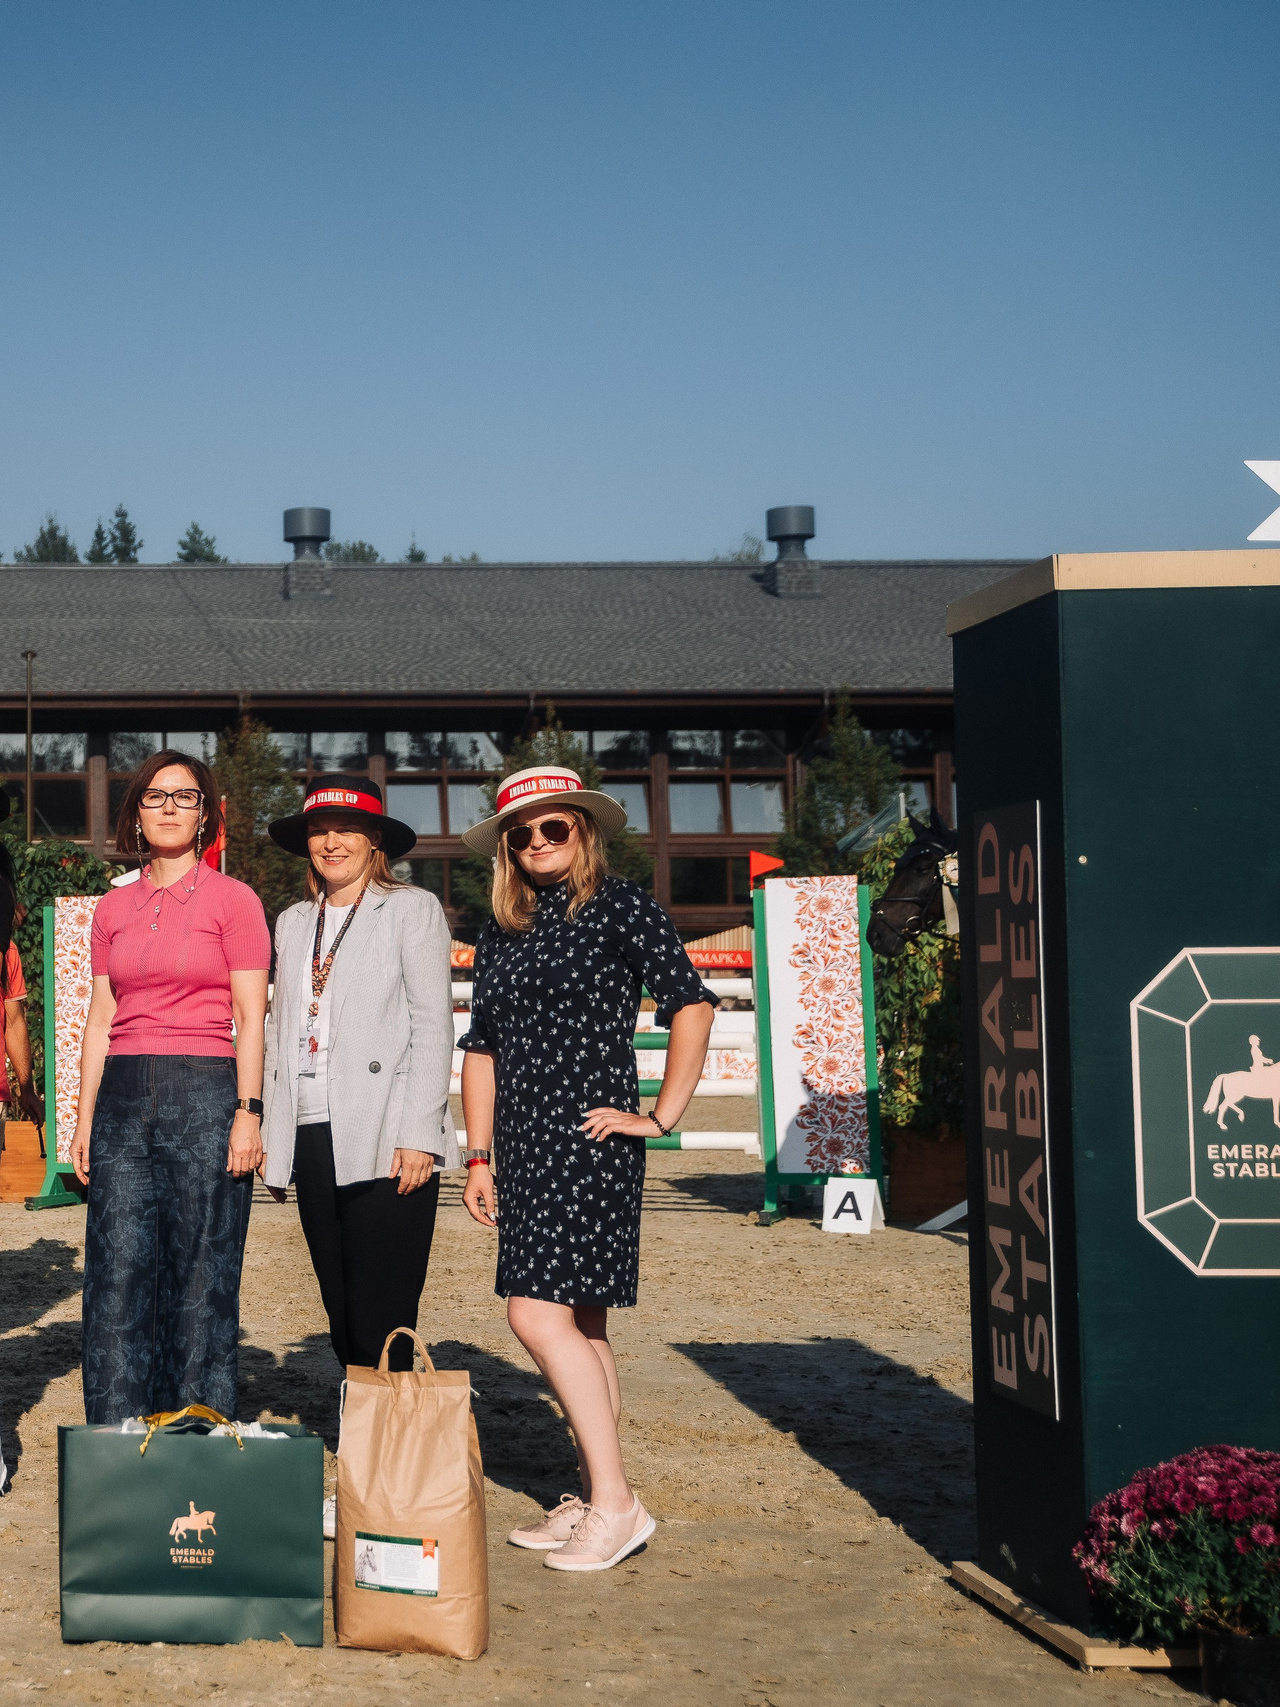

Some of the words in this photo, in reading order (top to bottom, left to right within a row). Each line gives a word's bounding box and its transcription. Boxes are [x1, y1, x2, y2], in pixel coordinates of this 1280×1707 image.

[317, 792, 344, 803] STABLES
[346, 793, 358, 804] CUP
[509, 781, 537, 798] EMERALD
[539, 779, 566, 790] STABLES
[976, 821, 1019, 1391] EMERALD
[1008, 842, 1050, 1380] STABLES
[832, 1191, 863, 1221] A
[170, 1548, 215, 1556] EMERALD
[172, 1556, 213, 1564] STABLES
